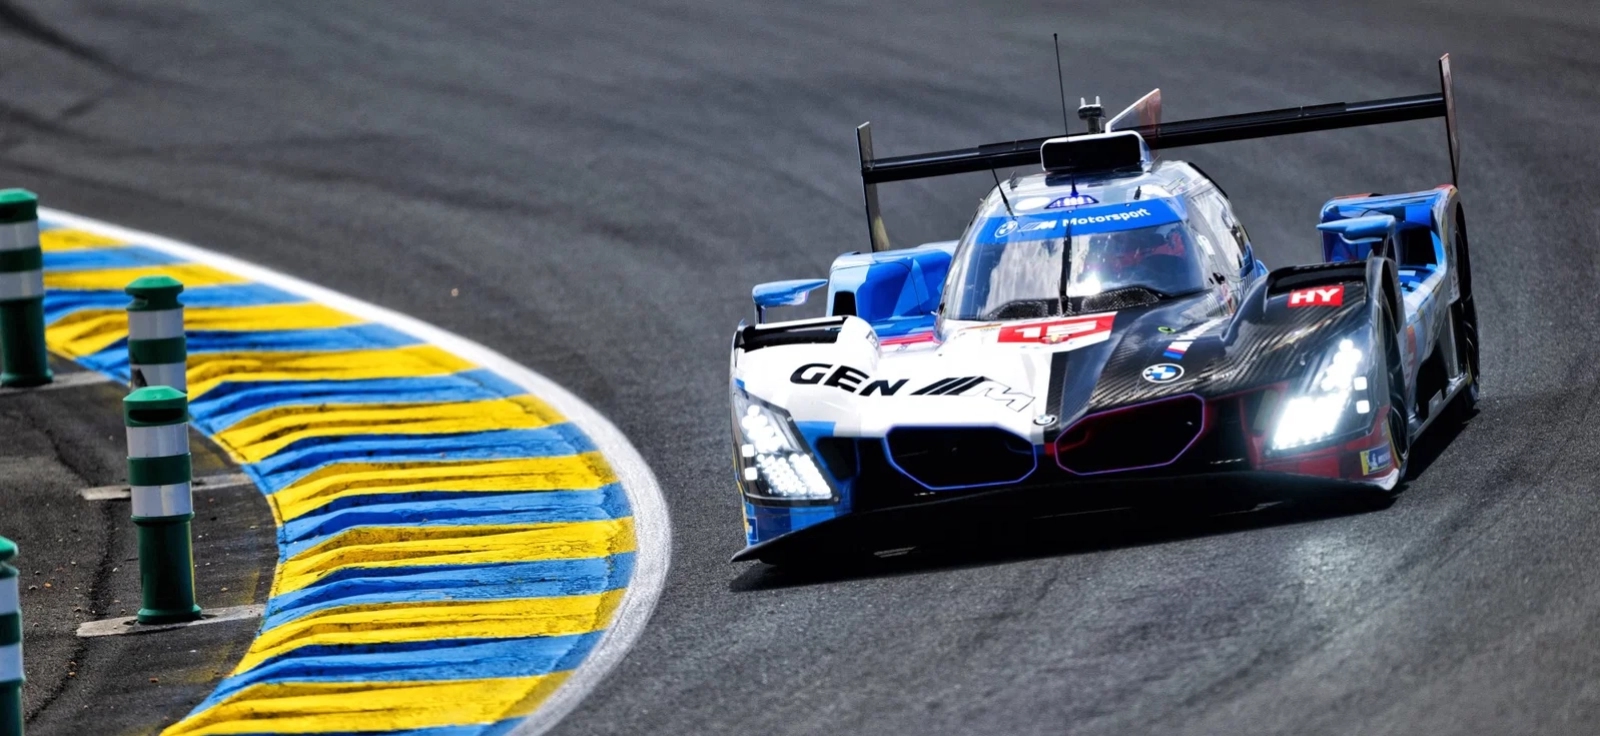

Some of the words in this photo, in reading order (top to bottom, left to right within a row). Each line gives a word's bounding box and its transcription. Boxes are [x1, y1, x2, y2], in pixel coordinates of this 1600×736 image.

[1062, 207, 1151, 227] Motorsport
[1290, 288, 1341, 304] HY
[790, 363, 910, 396] GEN
